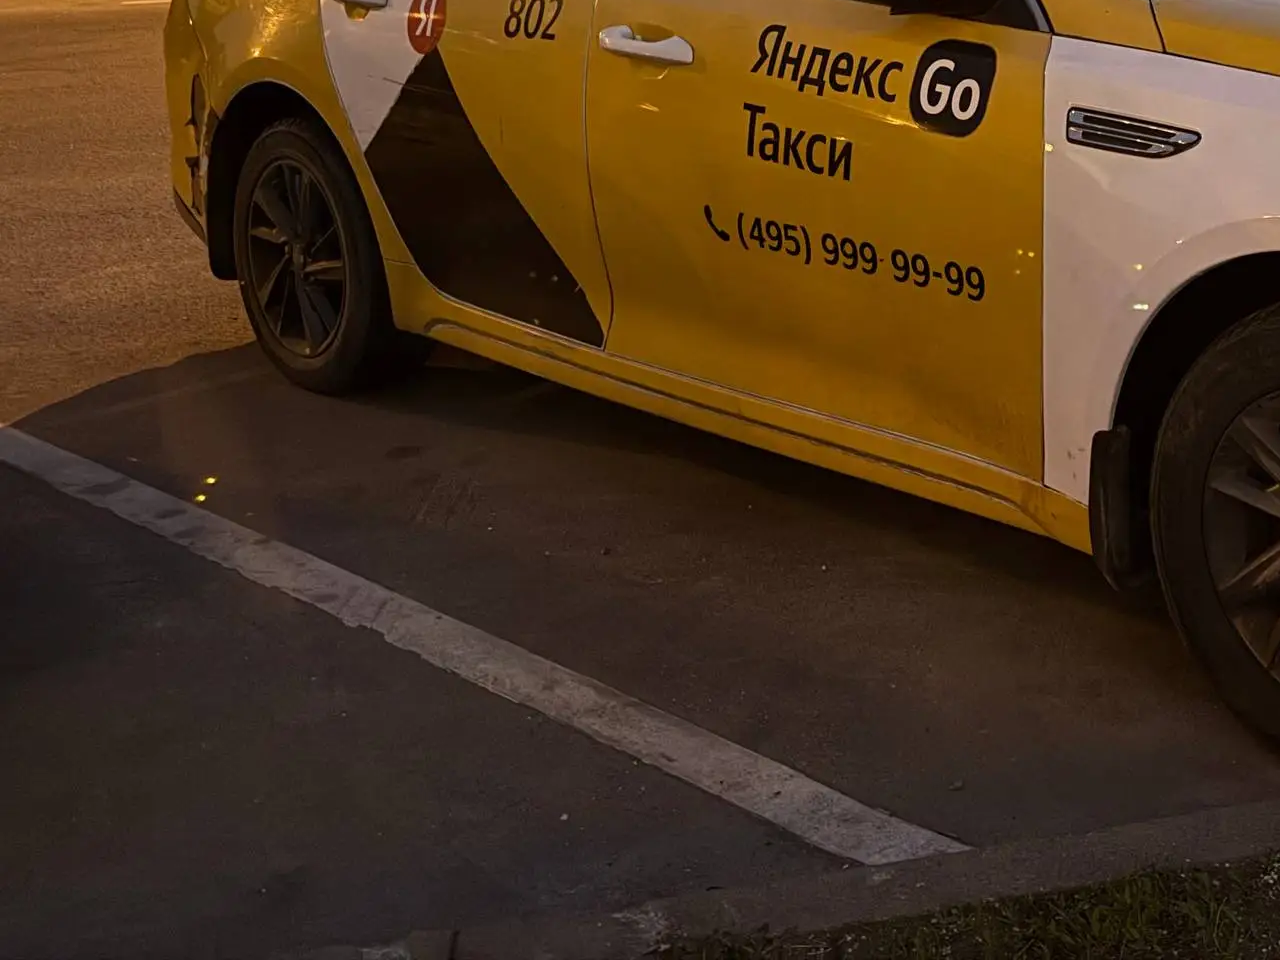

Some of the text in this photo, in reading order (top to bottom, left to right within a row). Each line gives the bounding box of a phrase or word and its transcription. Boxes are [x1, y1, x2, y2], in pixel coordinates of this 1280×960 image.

[751, 24, 981, 122] Яндекс Go
[743, 103, 853, 182] Такси
[737, 212, 812, 265] (495)
